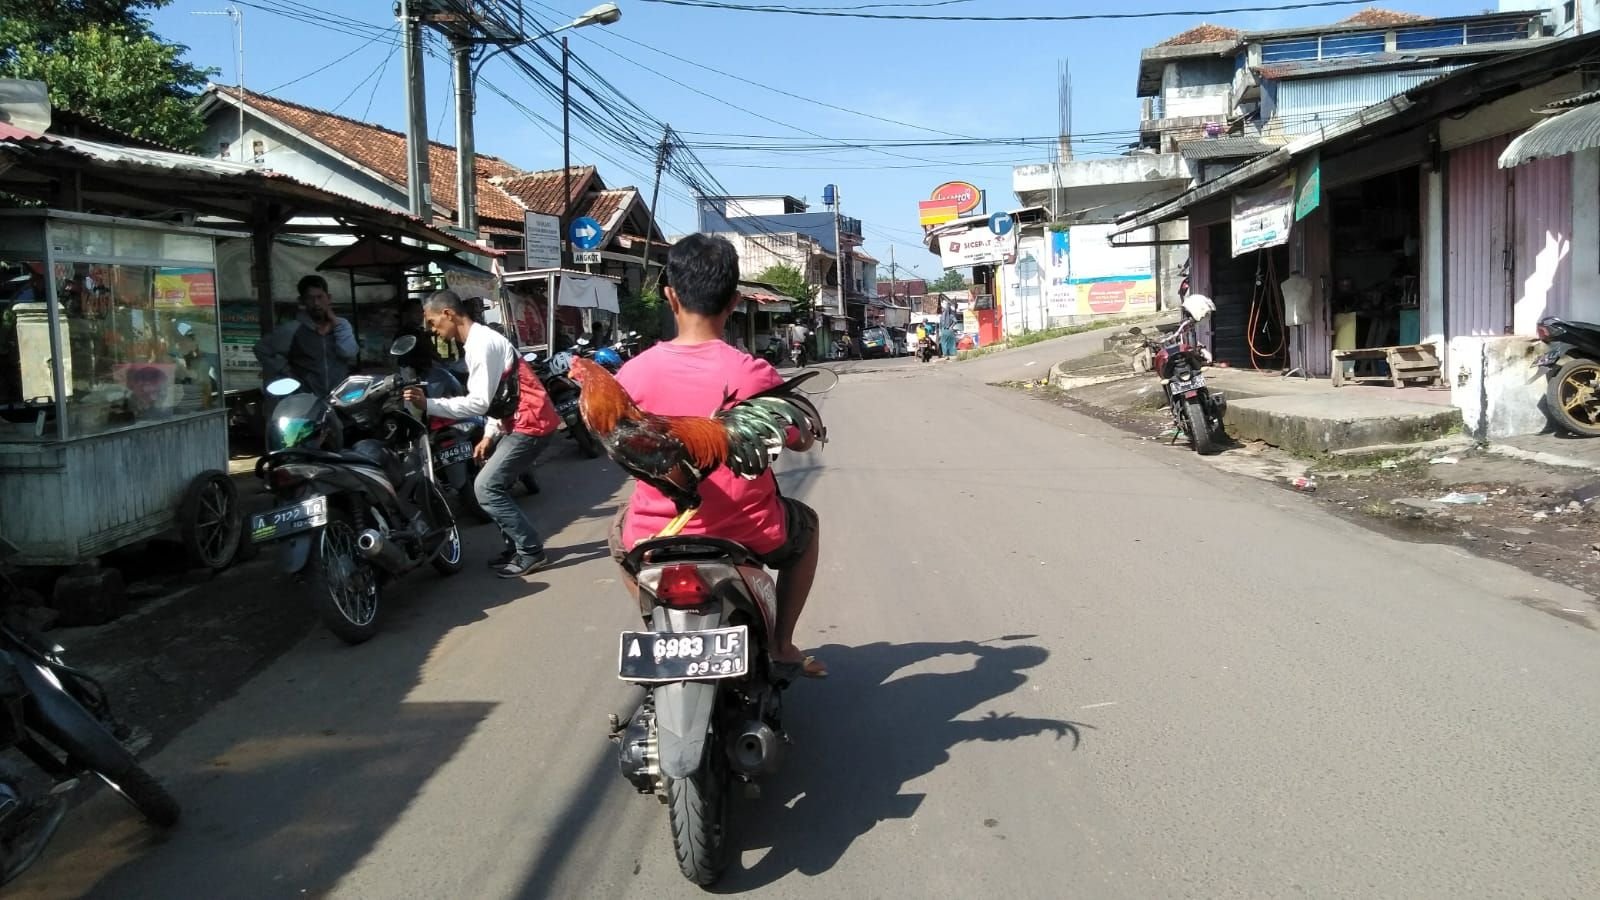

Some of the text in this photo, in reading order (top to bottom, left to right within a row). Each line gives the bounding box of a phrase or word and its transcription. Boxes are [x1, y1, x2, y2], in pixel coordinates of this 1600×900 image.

[575, 254, 599, 262] ANGKOT
[258, 518, 265, 528] A
[274, 509, 300, 525] 2122
[628, 633, 740, 658] A 6983 LF
